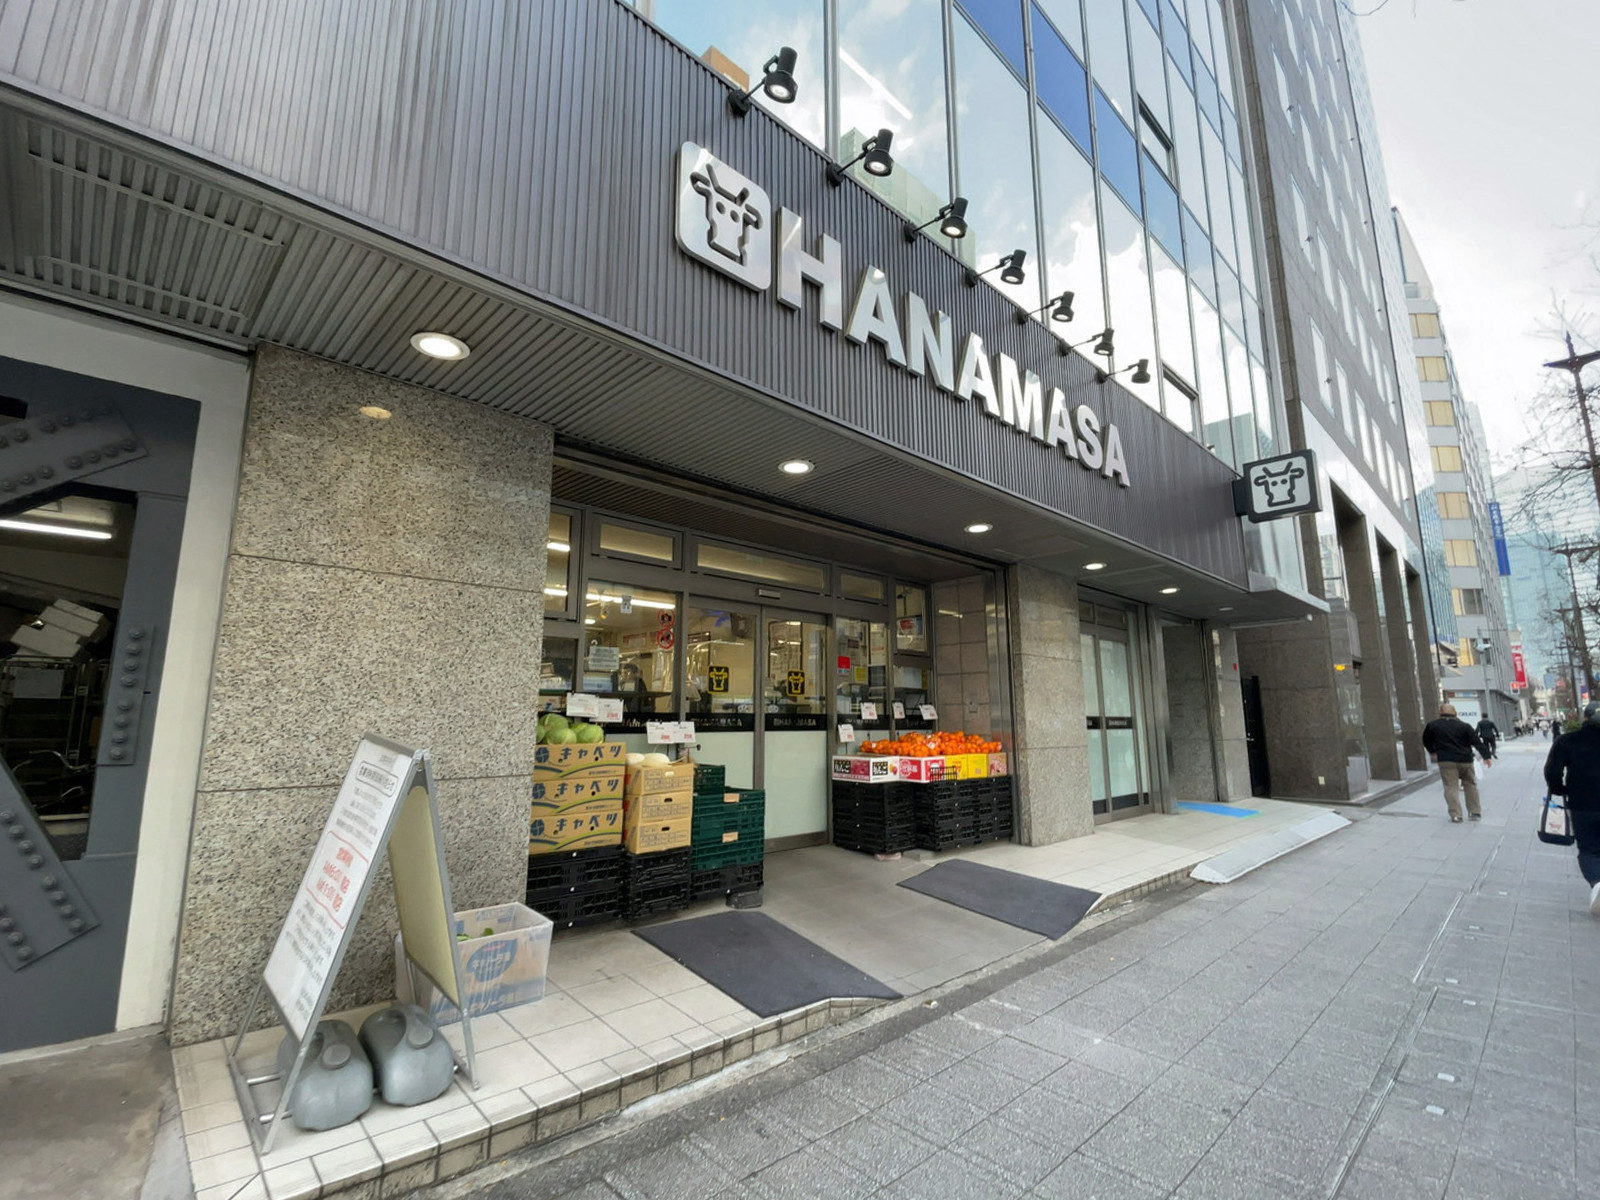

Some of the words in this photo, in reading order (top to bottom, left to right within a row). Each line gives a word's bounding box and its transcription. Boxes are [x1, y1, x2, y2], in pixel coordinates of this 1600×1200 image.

[777, 206, 1131, 488] HANAMASA
[561, 745, 622, 760] キャベツ
[558, 779, 619, 795] キャベツ
[556, 813, 618, 831] キャベツ
